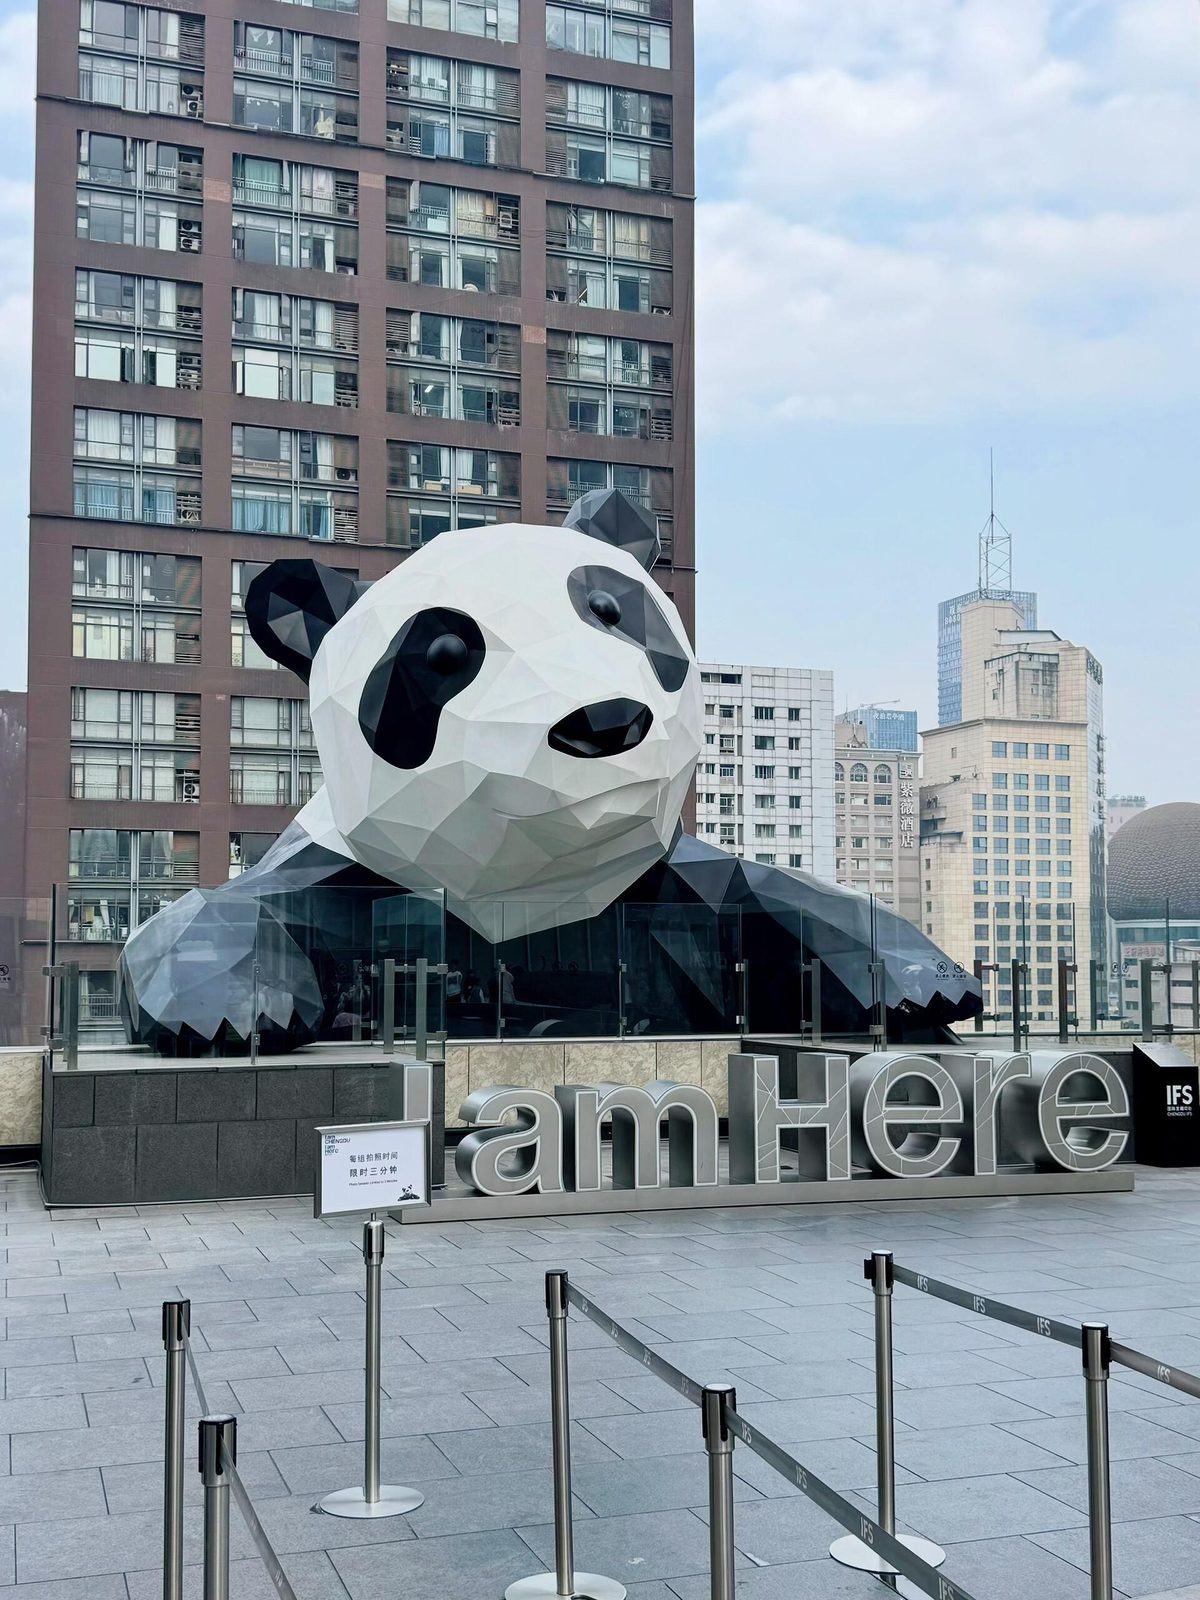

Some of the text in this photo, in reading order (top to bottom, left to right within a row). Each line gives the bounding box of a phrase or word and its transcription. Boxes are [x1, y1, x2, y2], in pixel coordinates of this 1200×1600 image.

[900, 782, 914, 848] 紫薇酒店
[1166, 1085, 1193, 1105] IFS
[455, 1081, 721, 1196] am
[729, 1051, 1133, 1184] Here
[350, 1152, 398, 1163] 每组拍照时间
[350, 1165, 398, 1178] 限时三分钟
[917, 1275, 1051, 1336] IFS IFS IFS
[1157, 1365, 1171, 1383] IFS
[741, 1421, 752, 1444] IFS
[795, 1464, 808, 1489] IFS
[860, 1517, 875, 1544] IFS
